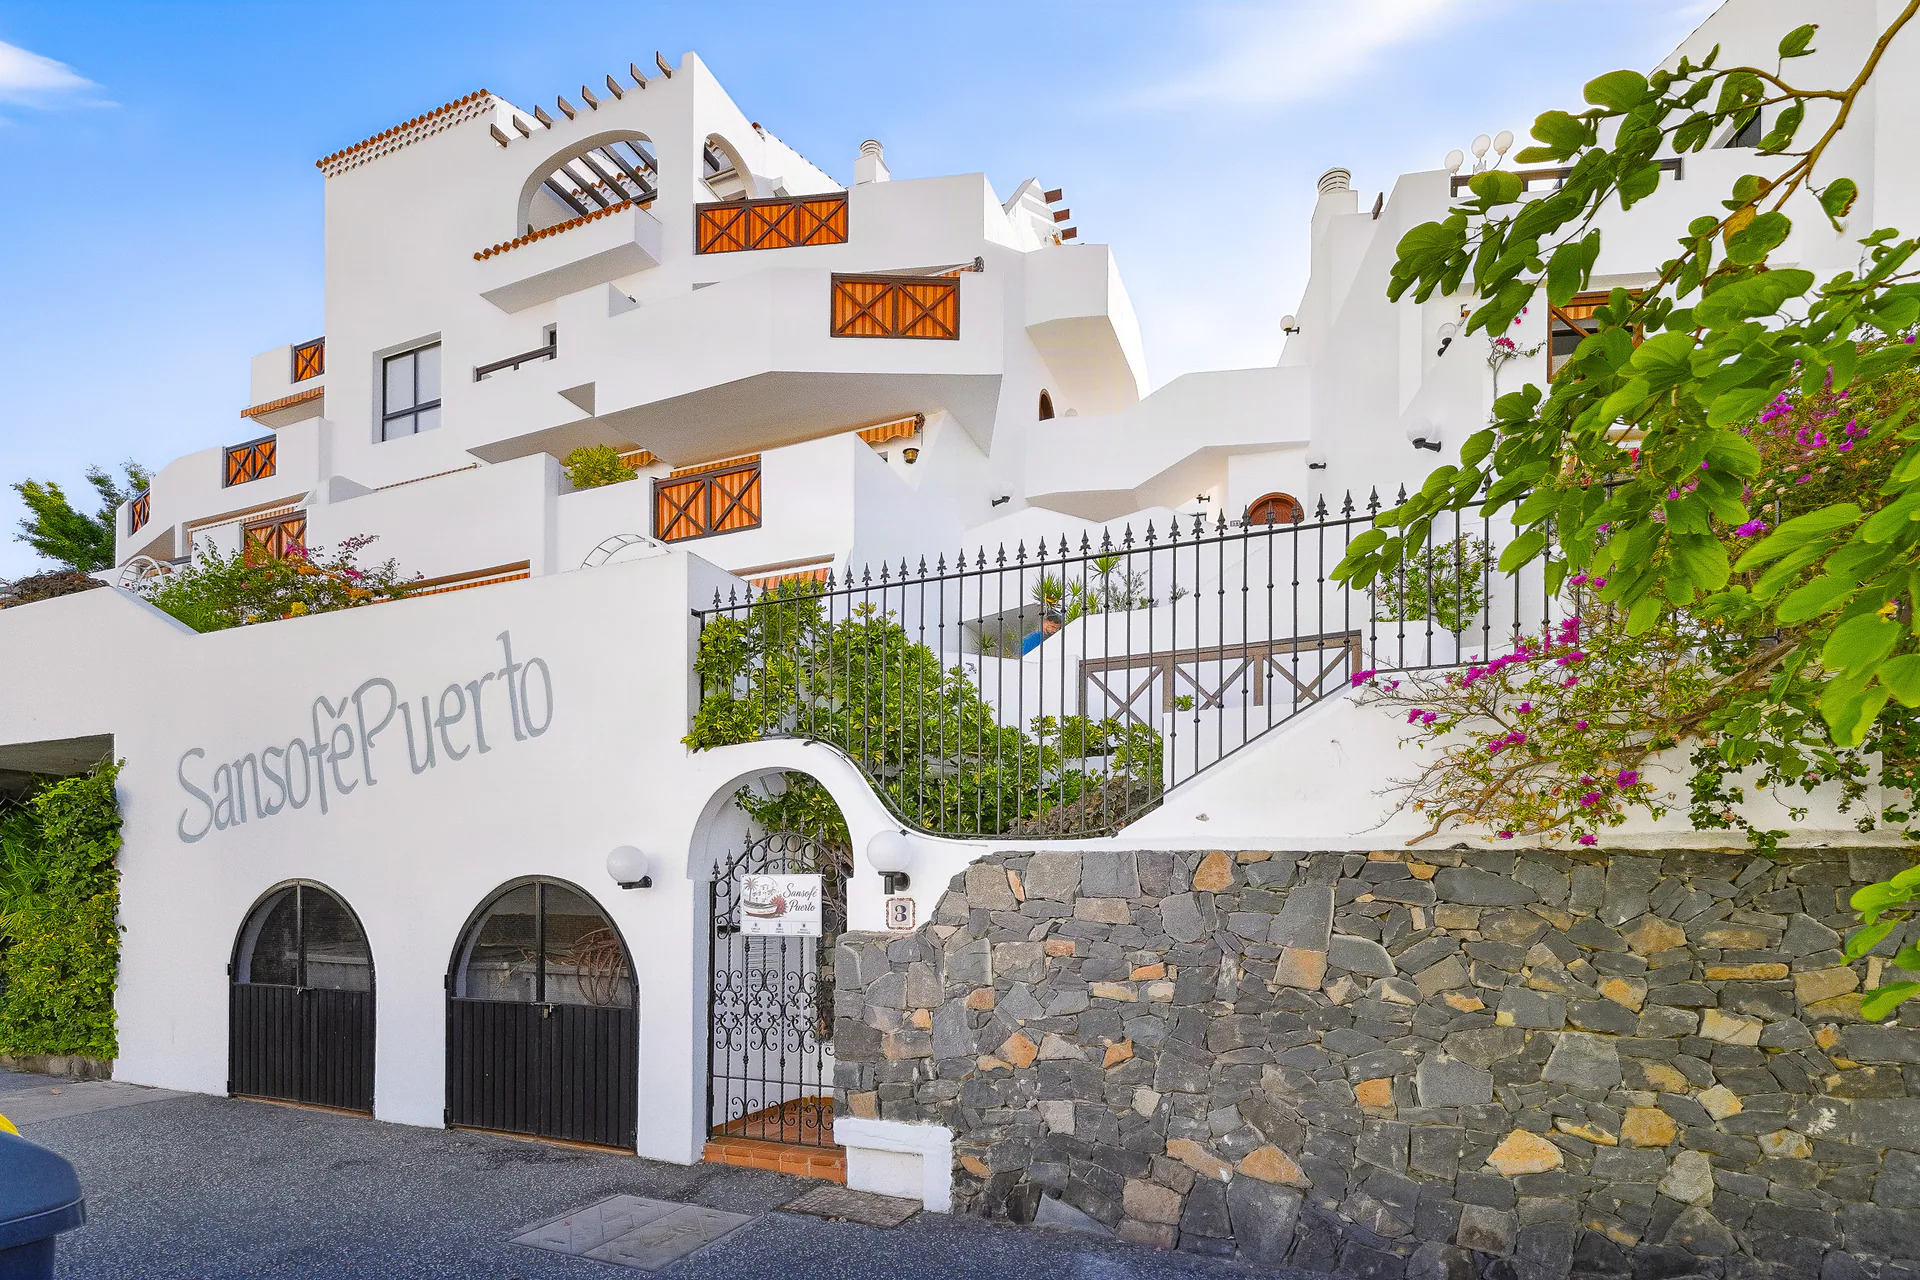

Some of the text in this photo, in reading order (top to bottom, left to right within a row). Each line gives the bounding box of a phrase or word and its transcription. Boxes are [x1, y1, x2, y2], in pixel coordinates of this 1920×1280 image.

[783, 883, 818, 900] Sansofé
[788, 899, 816, 912] Puerto
[894, 904, 907, 923] 3
